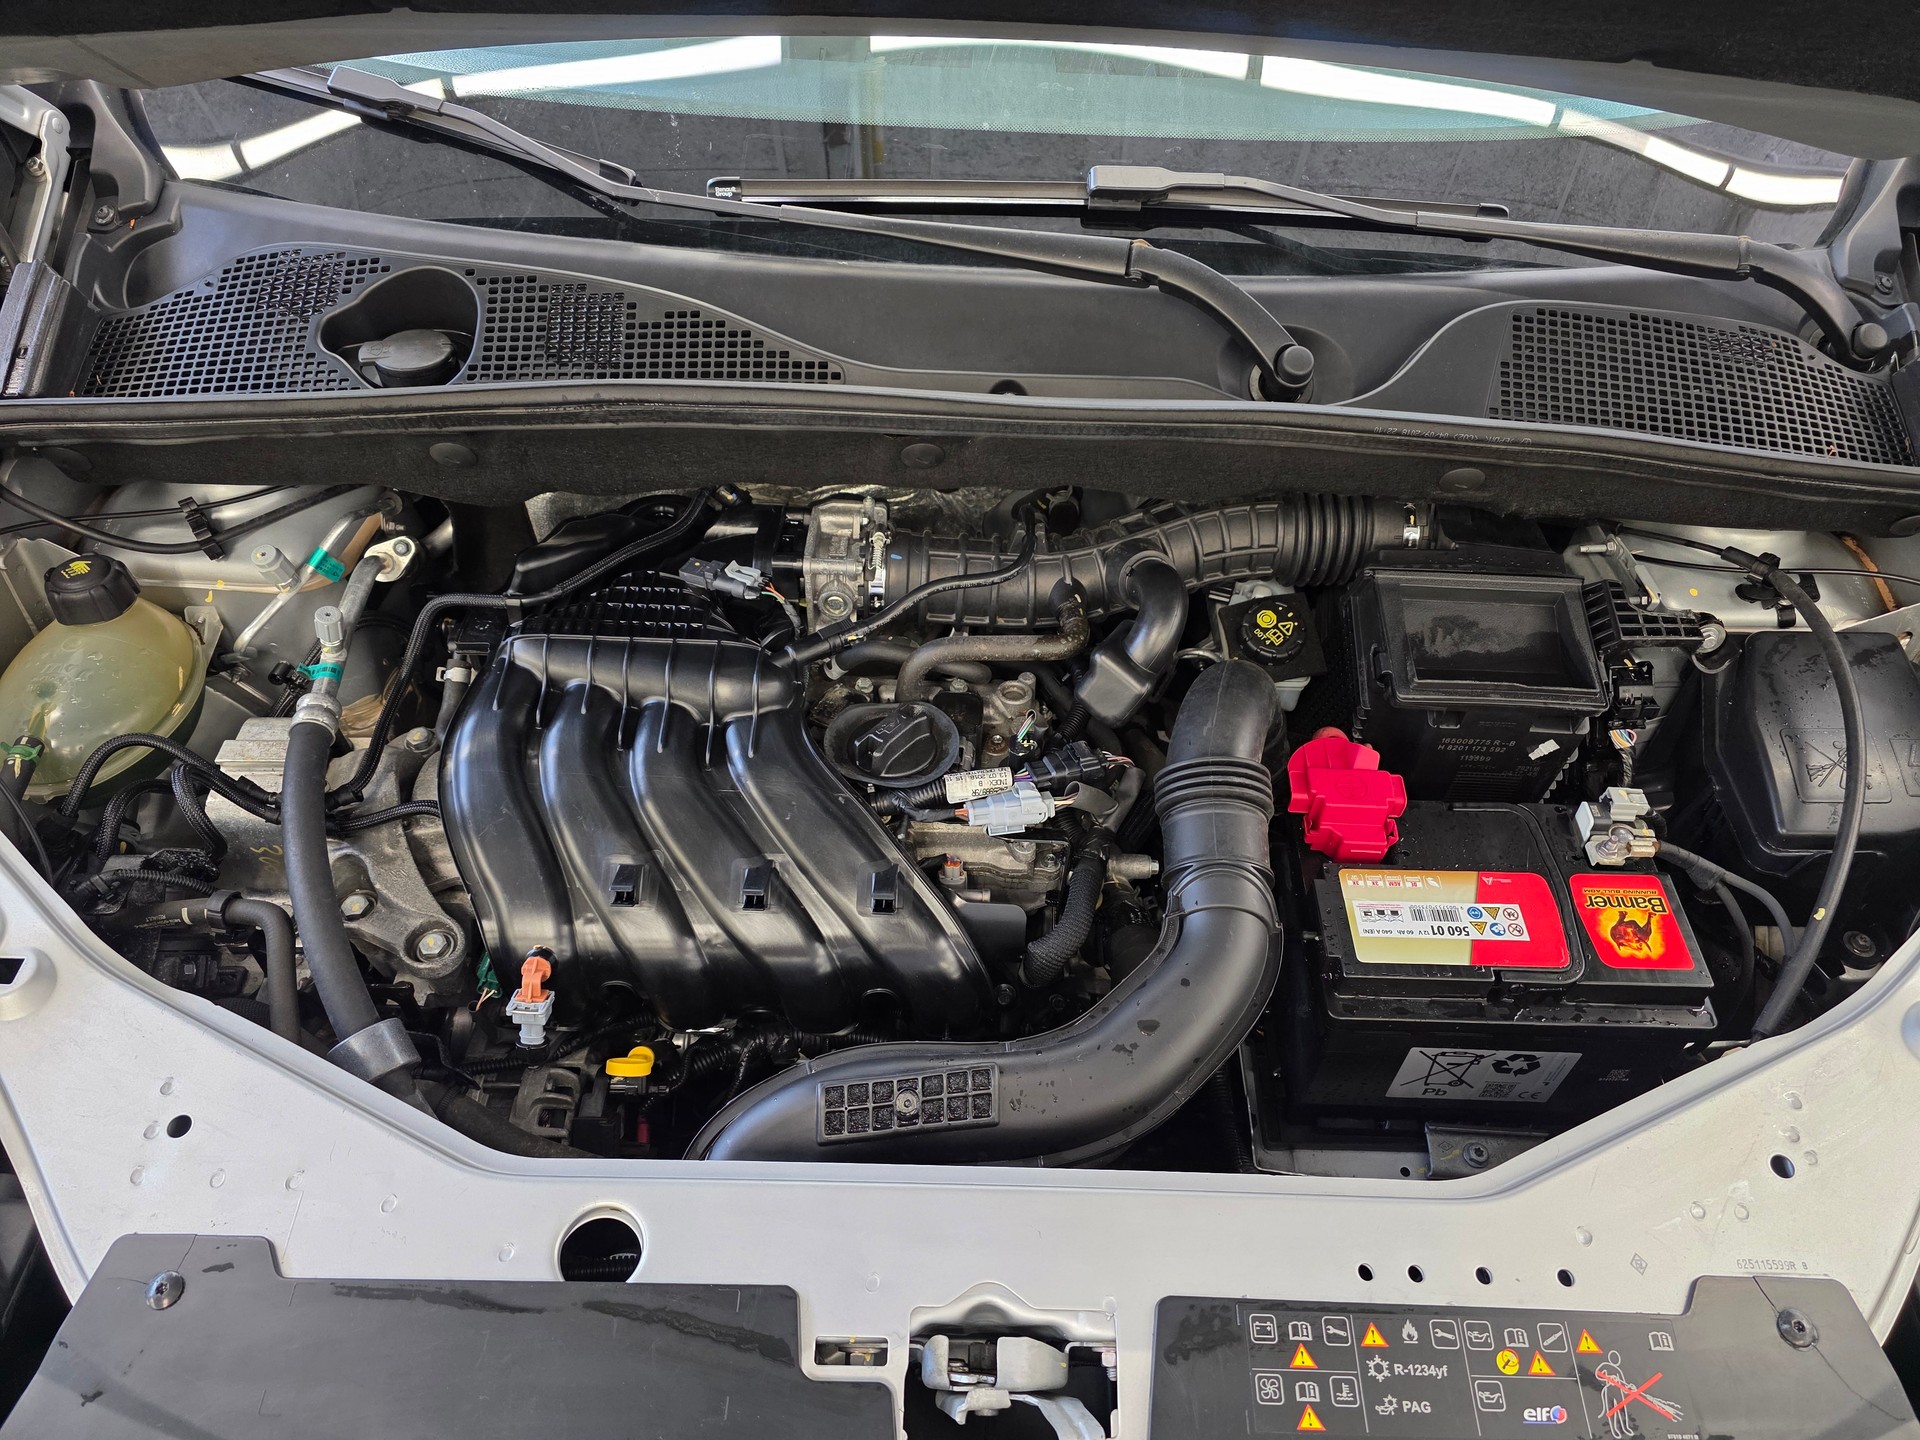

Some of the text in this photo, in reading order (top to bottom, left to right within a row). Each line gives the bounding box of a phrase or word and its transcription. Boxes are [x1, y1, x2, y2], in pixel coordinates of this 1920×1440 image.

[1254, 628, 1267, 640] DOT
[1586, 895, 1667, 913] Banner
[1430, 925, 1445, 936] 01
[1448, 926, 1470, 936] 560
[1422, 1088, 1447, 1096] Pb
[1737, 1258, 1796, 1270] 625115599R
[1394, 1363, 1448, 1379] R-1234yf
[1403, 1401, 1432, 1414] PAG
[1523, 1408, 1550, 1422] elf
